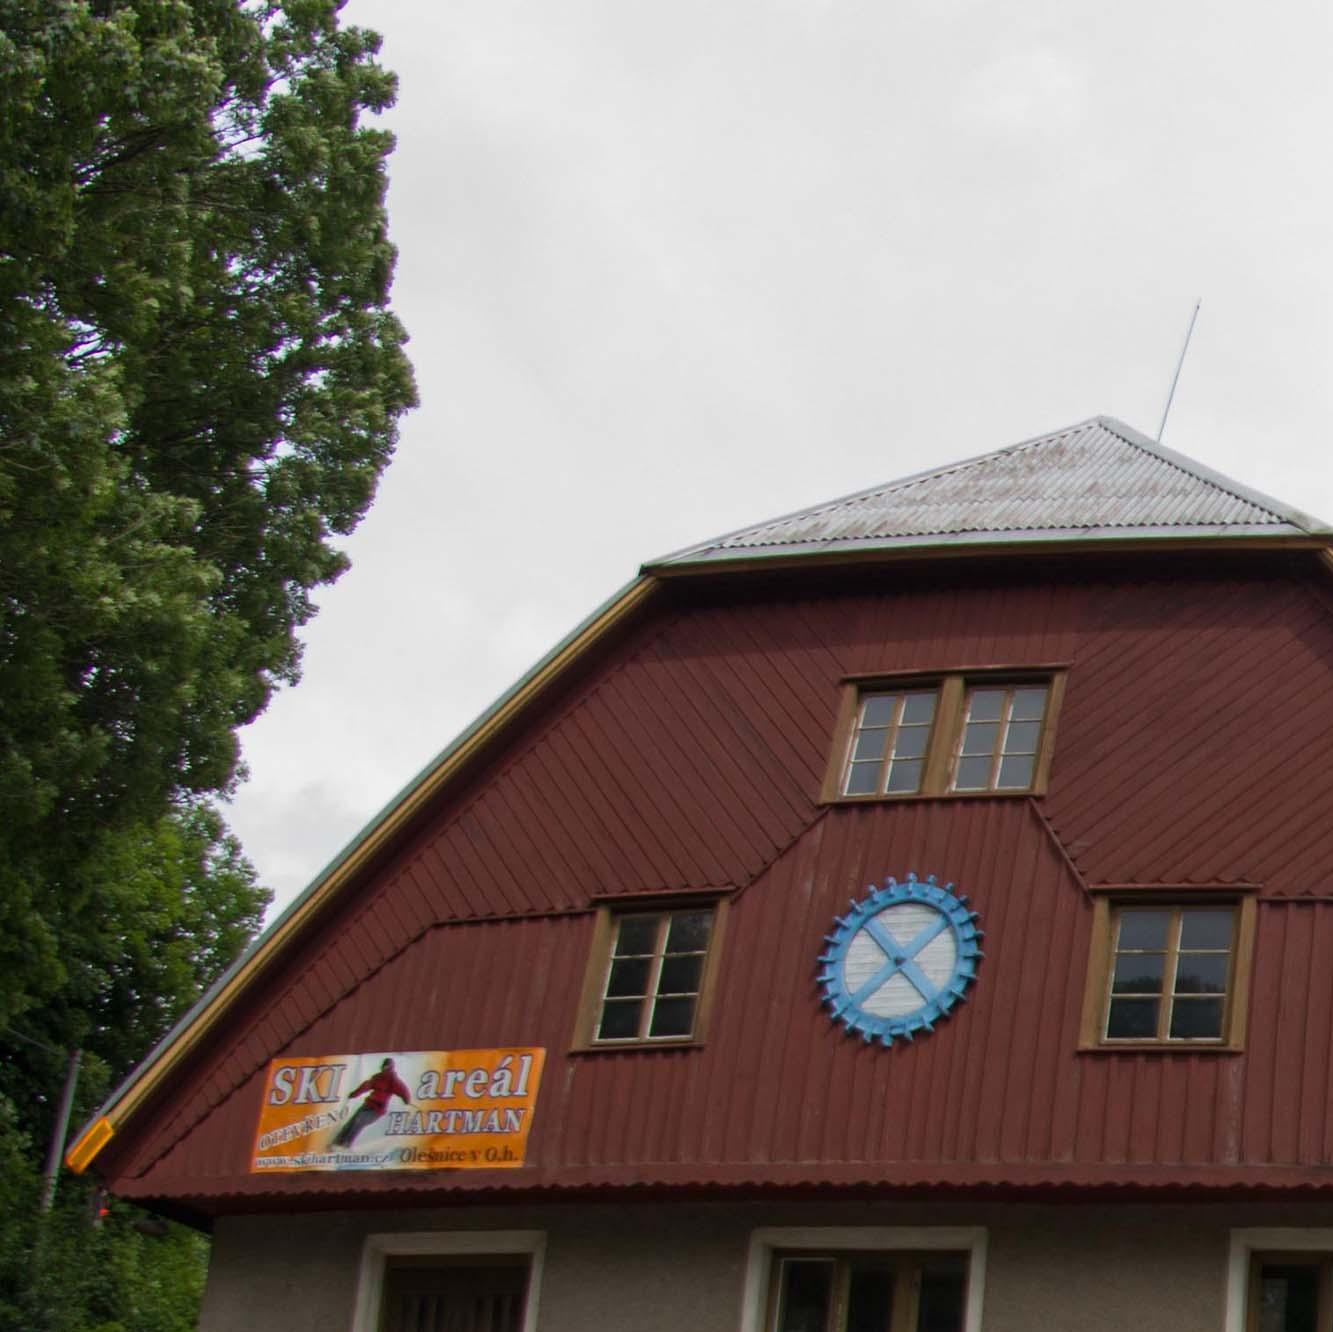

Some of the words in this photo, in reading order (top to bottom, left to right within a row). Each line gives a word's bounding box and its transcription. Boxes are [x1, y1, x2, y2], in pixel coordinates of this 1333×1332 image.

[269, 1063, 348, 1106] SKI
[416, 1054, 534, 1100] areál
[384, 1109, 527, 1136] HARTMAN
